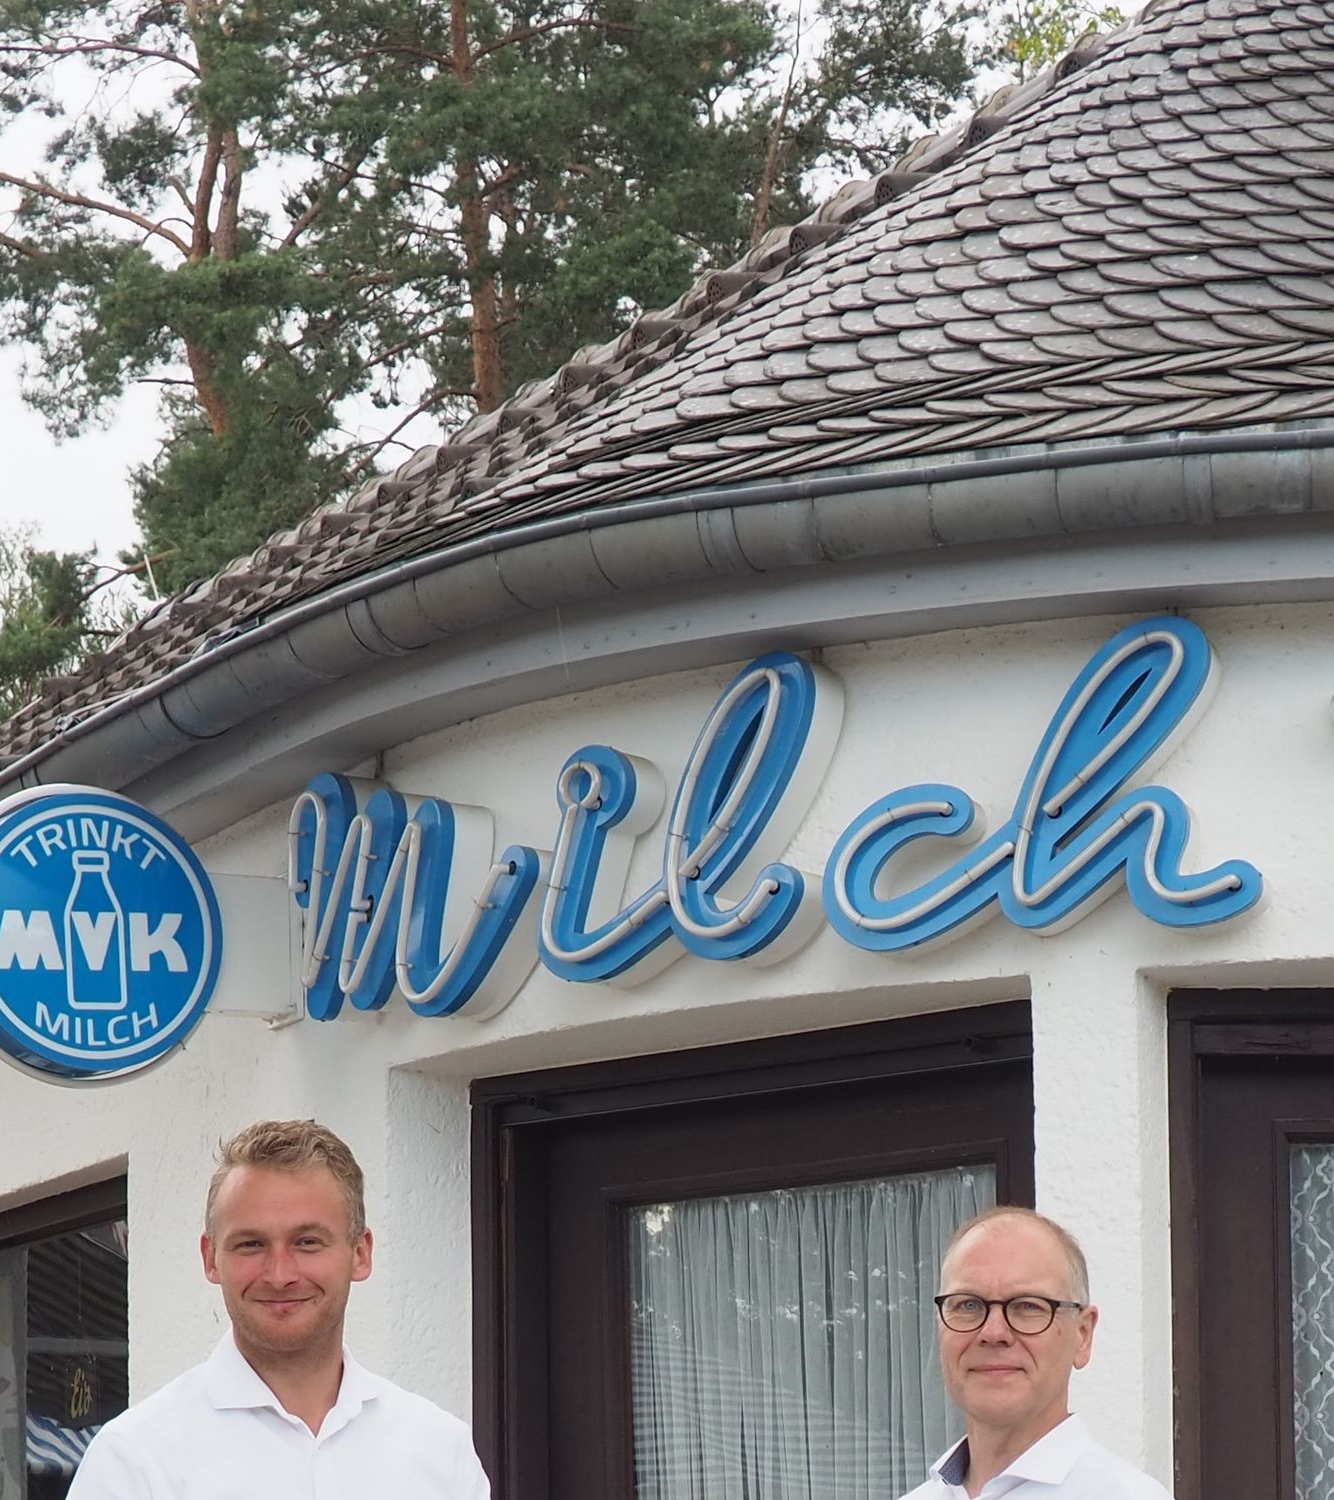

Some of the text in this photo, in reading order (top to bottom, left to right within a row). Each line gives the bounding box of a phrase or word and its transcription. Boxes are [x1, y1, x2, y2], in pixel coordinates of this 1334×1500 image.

[10, 817, 167, 870] TRINKT
[287, 616, 1263, 1022] Milch
[34, 1001, 159, 1047] MILCH
